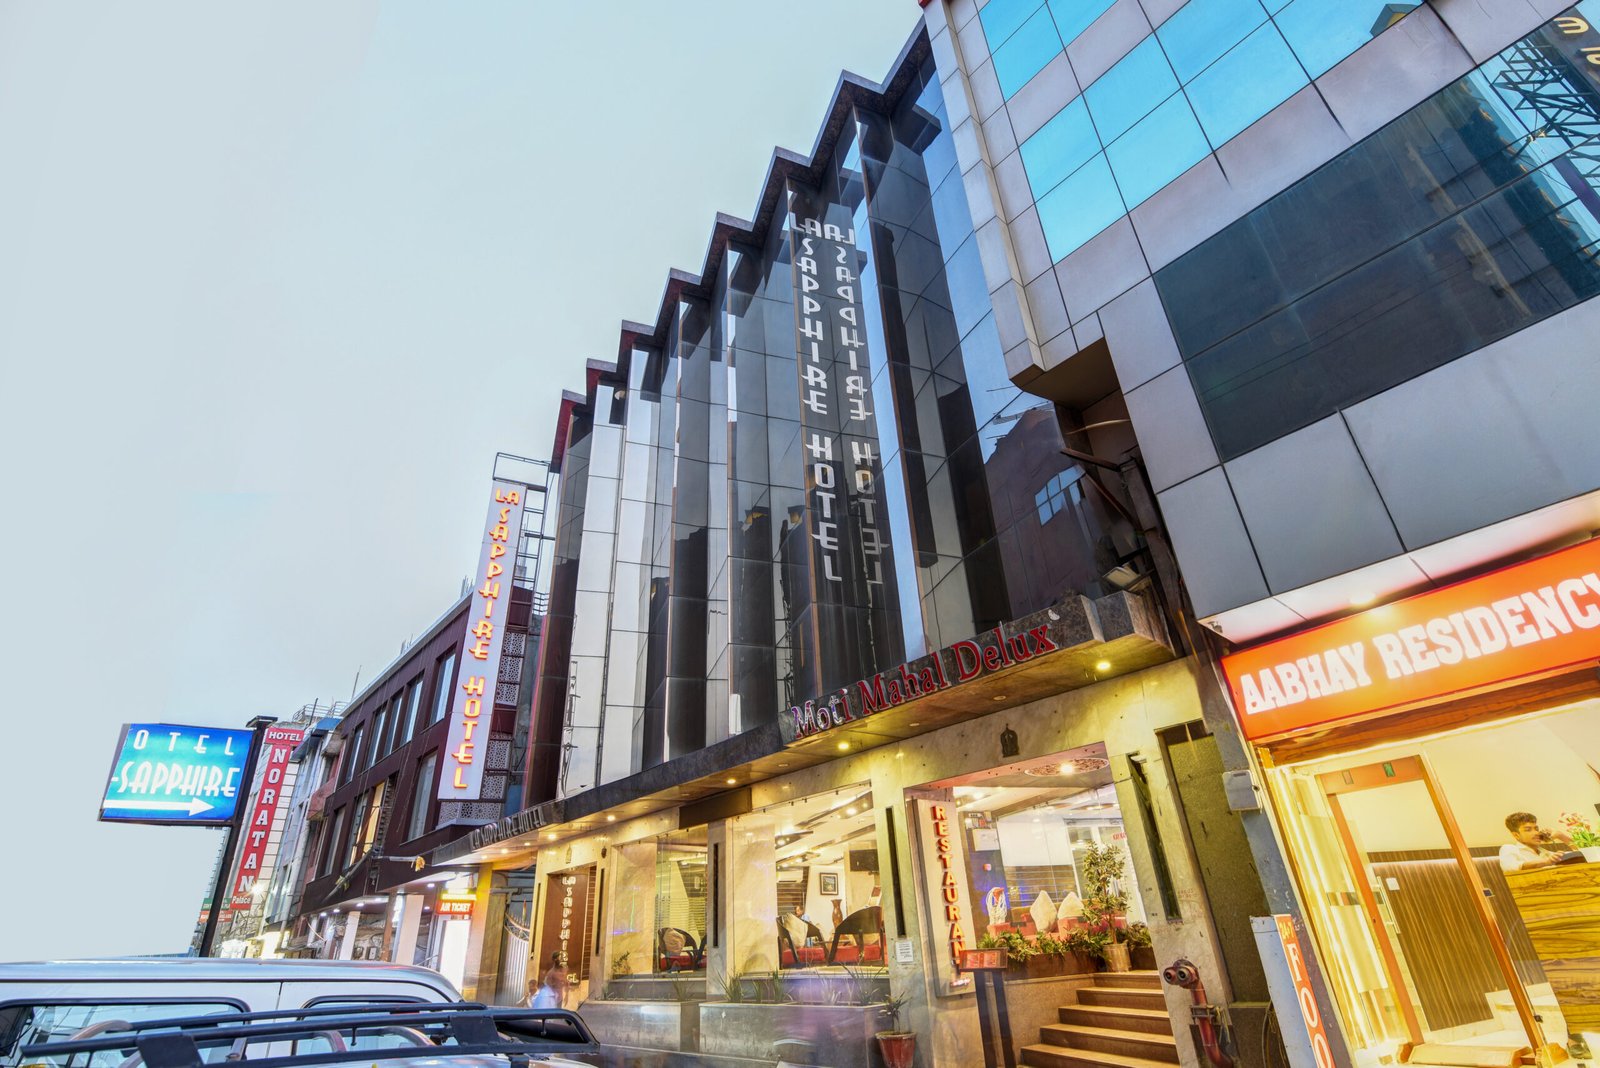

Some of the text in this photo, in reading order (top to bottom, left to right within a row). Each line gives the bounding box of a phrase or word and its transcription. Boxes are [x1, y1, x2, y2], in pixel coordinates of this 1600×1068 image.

[790, 212, 842, 582] LA SAPPHIRE HOTEL
[451, 487, 520, 789] LA SAPPHIRE HOTEL
[791, 621, 1059, 740] Moti Mahal Delux
[1240, 641, 1373, 715] AABHAY
[268, 731, 302, 742] HOTEL
[239, 748, 287, 893] NORATAN
[231, 895, 251, 905] Palace
[440, 902, 471, 912] AIR TICKET
